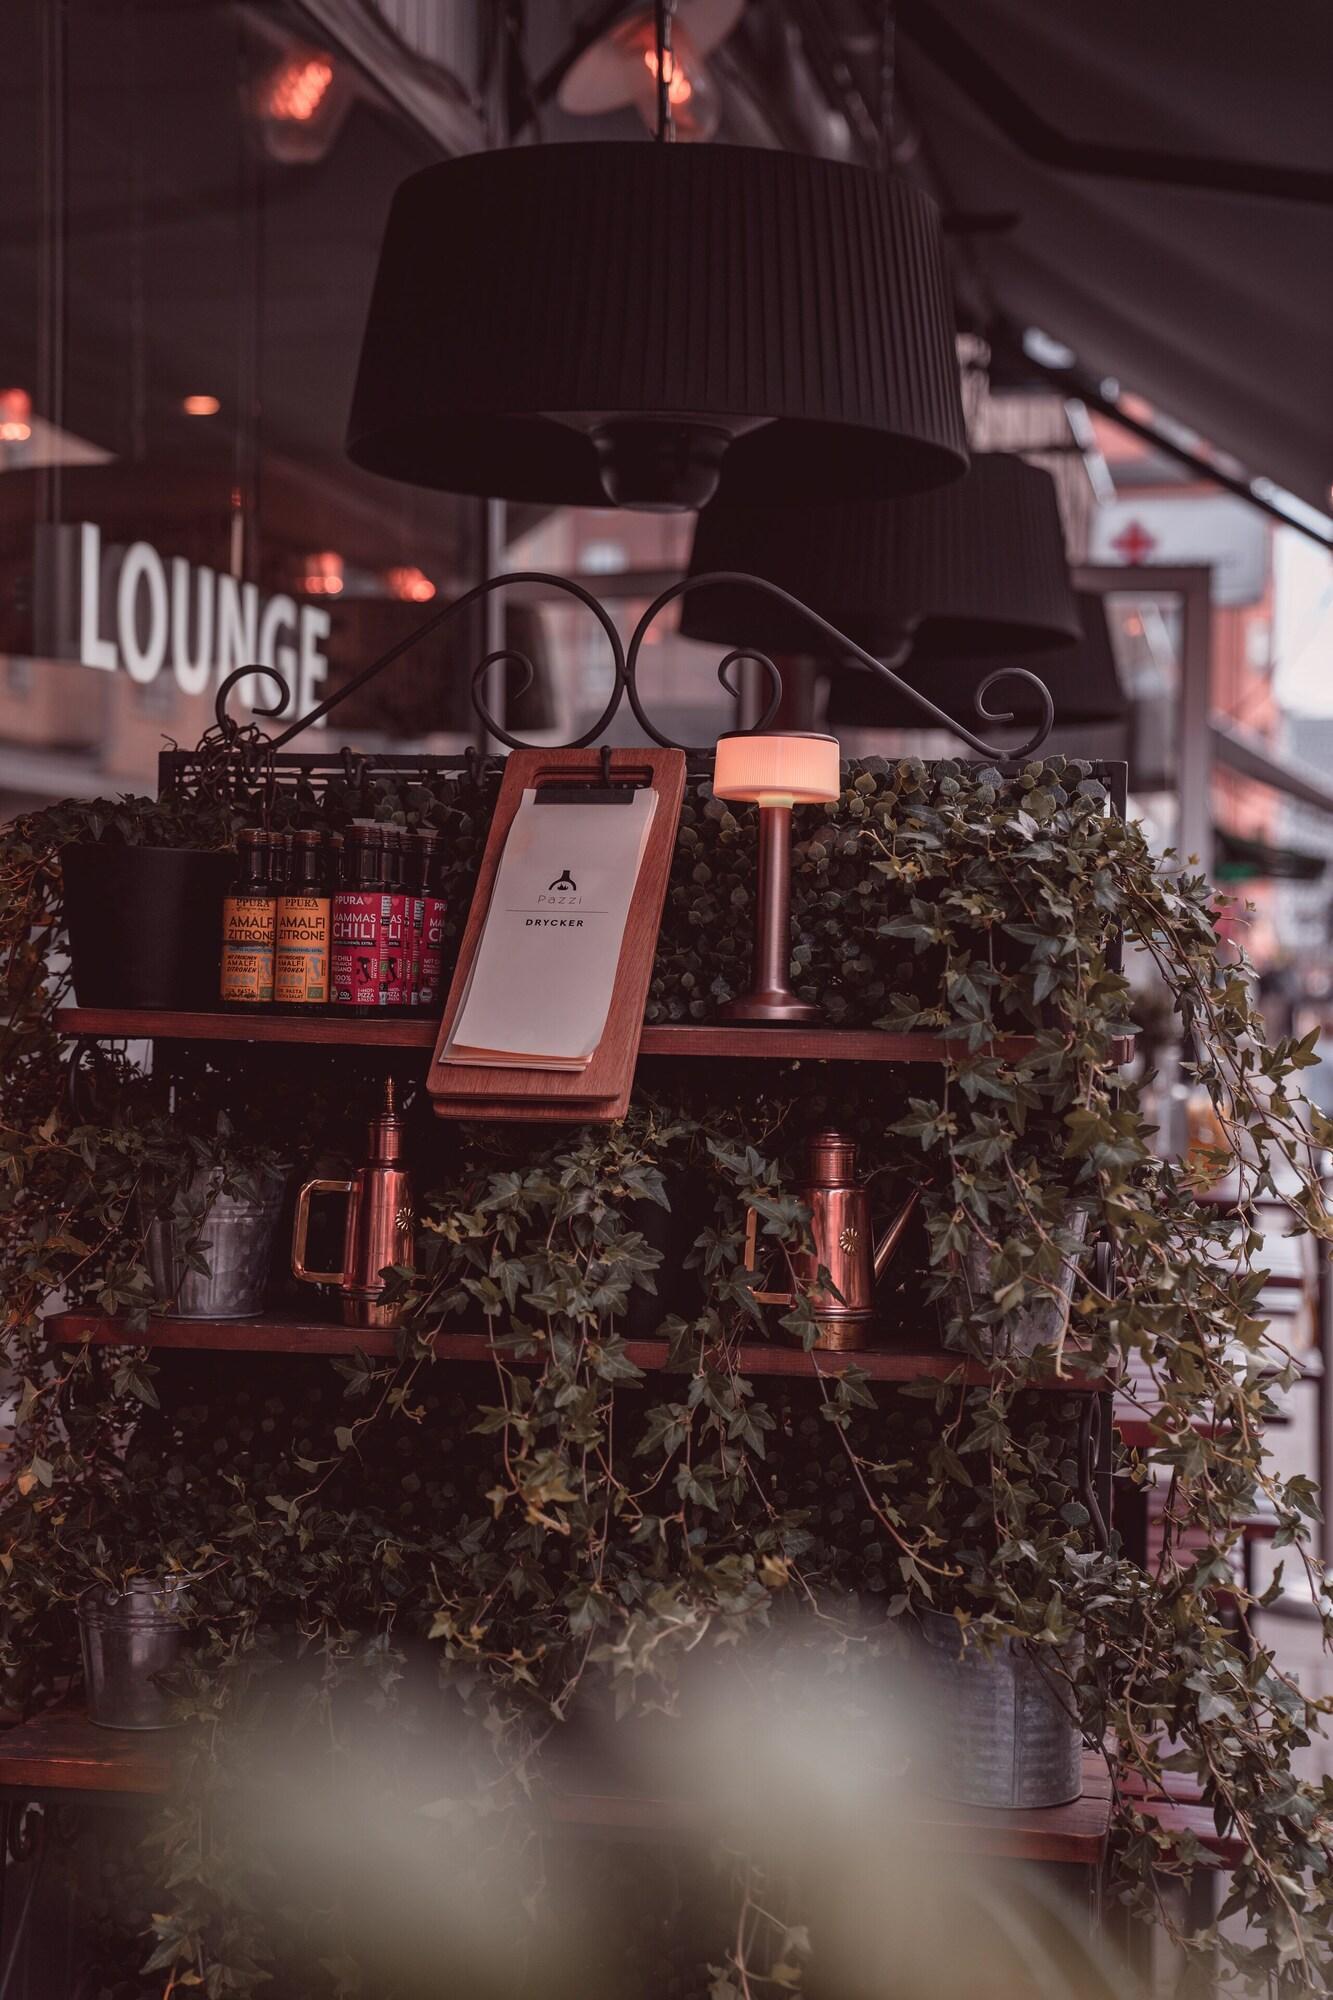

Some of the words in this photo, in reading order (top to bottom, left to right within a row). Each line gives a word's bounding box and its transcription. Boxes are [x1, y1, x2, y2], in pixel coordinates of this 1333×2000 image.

[81, 521, 331, 729] LOUNGE
[285, 898, 319, 907] PPURA
[335, 895, 364, 905] PPURA
[537, 894, 583, 905] Pazzi
[229, 917, 275, 928] AMALFI
[279, 916, 325, 929] AMALFI
[525, 918, 584, 927] DRYCKER
[228, 929, 276, 940] ZITRONE
[279, 930, 325, 940] ZITRONE
[333, 922, 375, 939] CHILI
